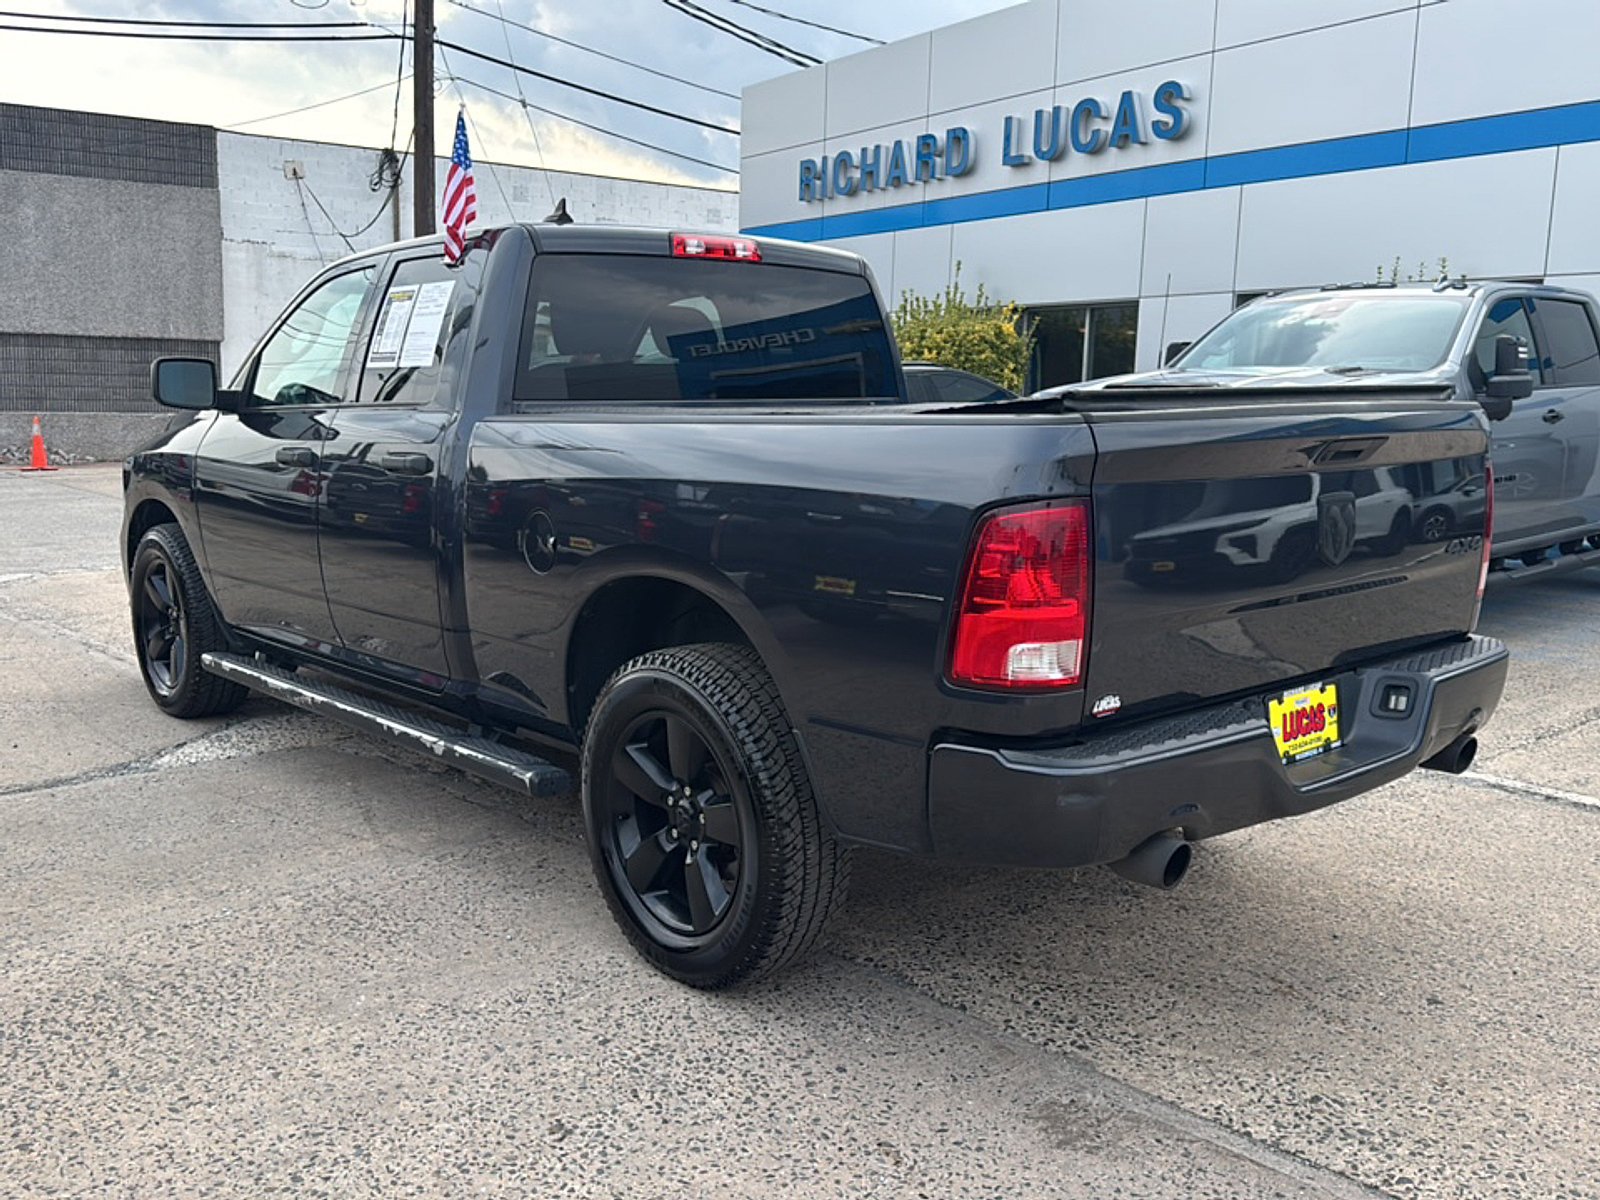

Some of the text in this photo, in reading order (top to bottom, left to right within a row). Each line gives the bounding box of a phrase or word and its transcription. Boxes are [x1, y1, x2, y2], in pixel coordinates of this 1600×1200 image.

[798, 80, 1192, 202] RICHARD LUCAS
[1092, 695, 1121, 713] LUCAS
[1283, 703, 1325, 742] LUCAS
